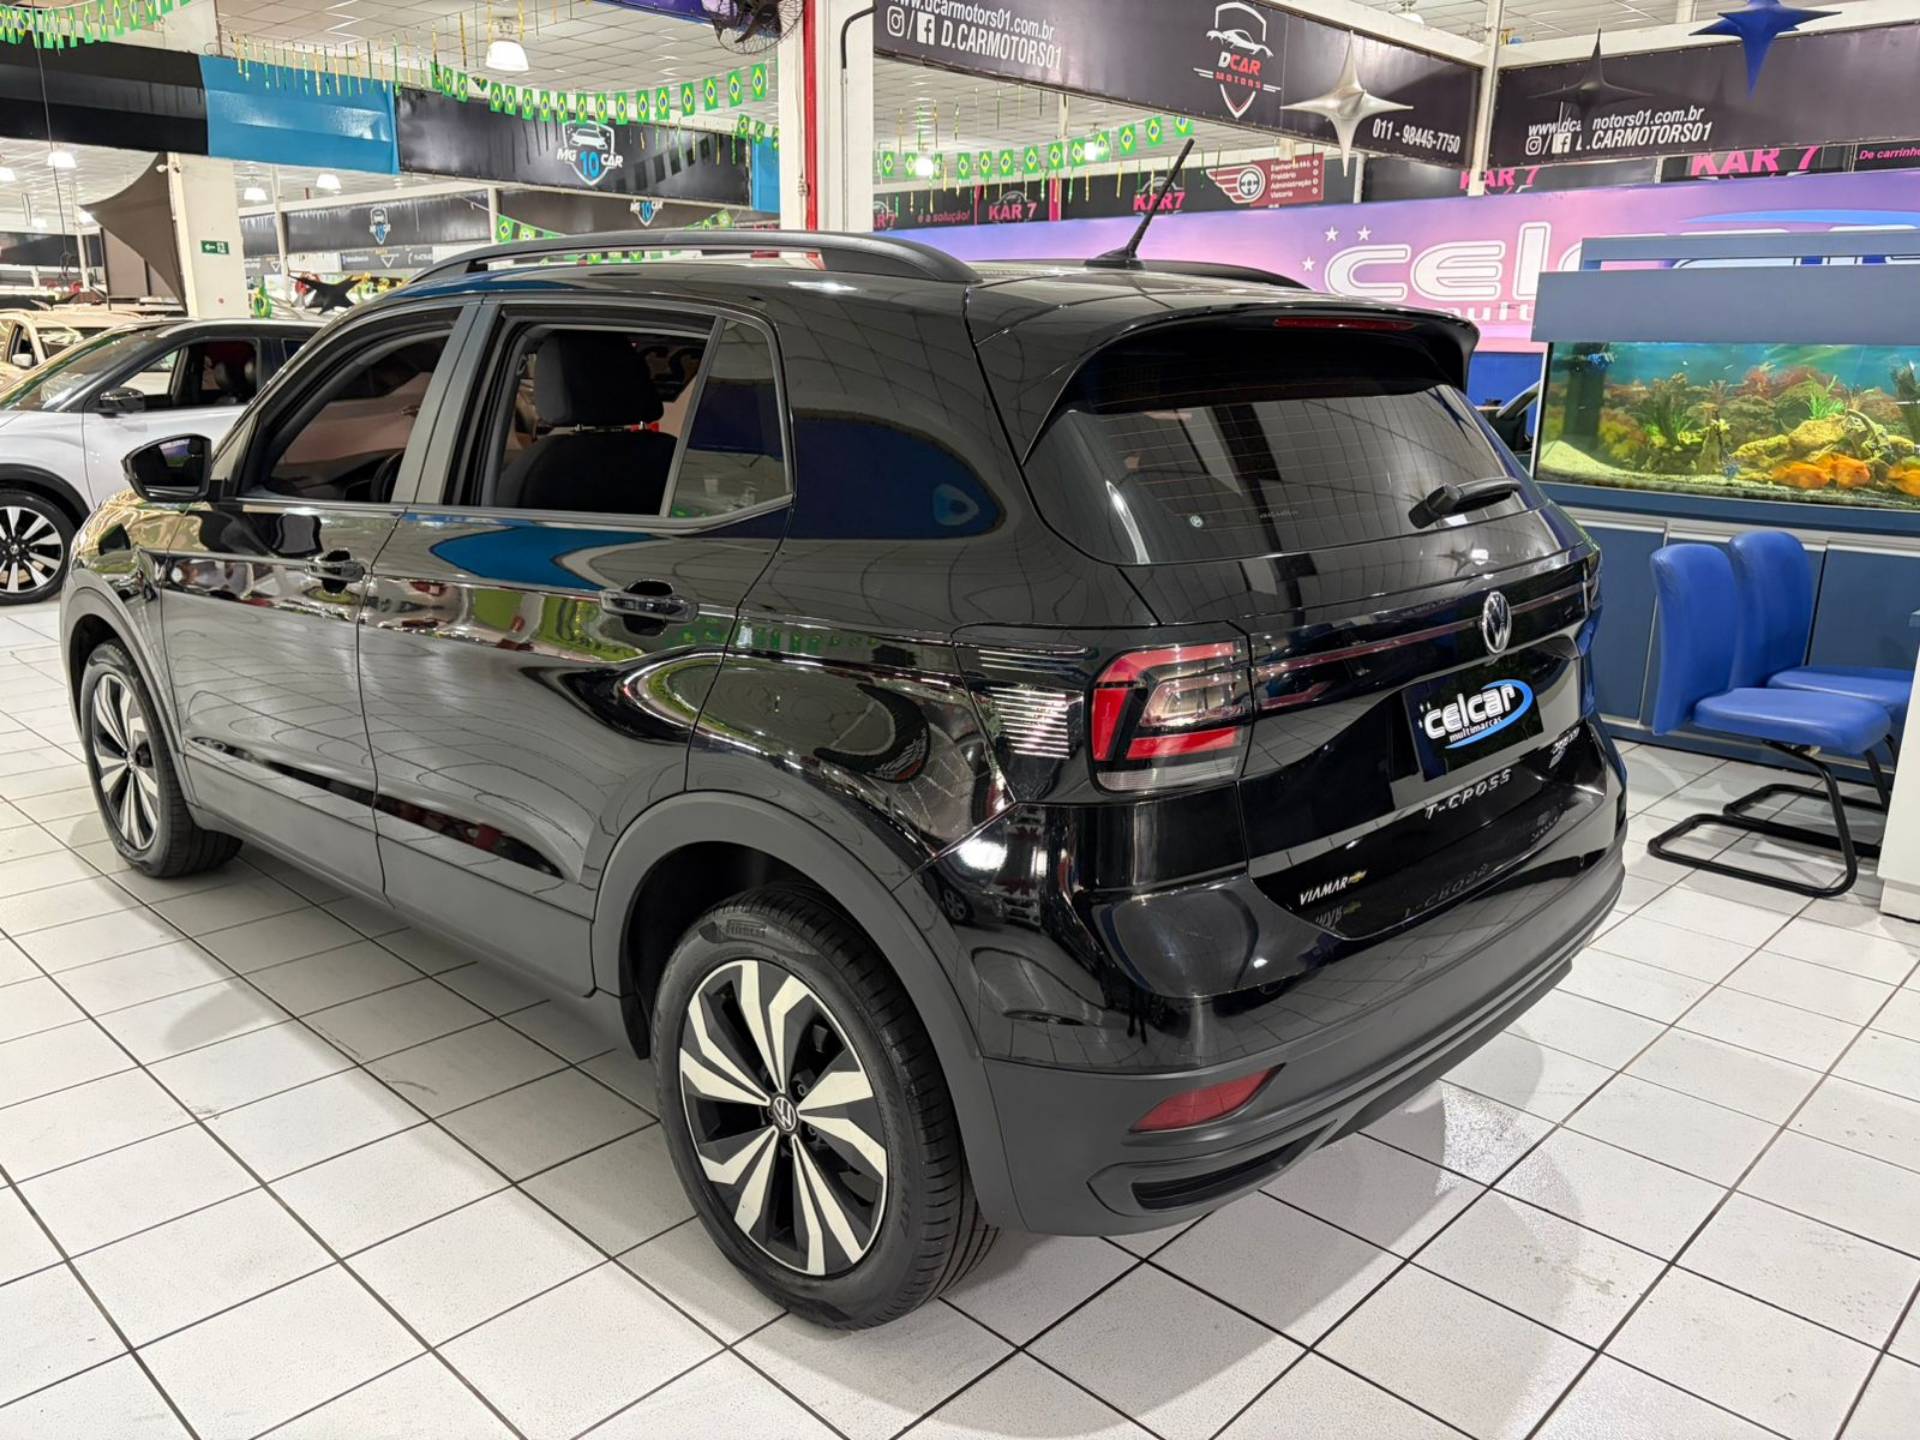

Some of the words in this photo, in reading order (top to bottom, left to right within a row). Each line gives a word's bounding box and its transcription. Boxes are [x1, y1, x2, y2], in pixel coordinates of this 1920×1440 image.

[890, 0, 1055, 40] w.dcarmotors01.com.br
[941, 20, 1063, 70] D.CARMOTORS01
[1218, 51, 1262, 76] DCAR
[1216, 71, 1262, 89] MOTORS
[1372, 118, 1393, 140] 011
[1402, 124, 1461, 154] 98445-7750
[557, 148, 577, 161] MG
[580, 151, 600, 179] 10
[601, 154, 624, 168] CAR
[1690, 147, 1780, 176] KAR
[1859, 150, 1874, 160] De
[988, 203, 1022, 221] KAR
[1026, 202, 1038, 219] 7
[1424, 683, 1516, 740] celcar
[1300, 876, 1349, 906] VIAMAR
